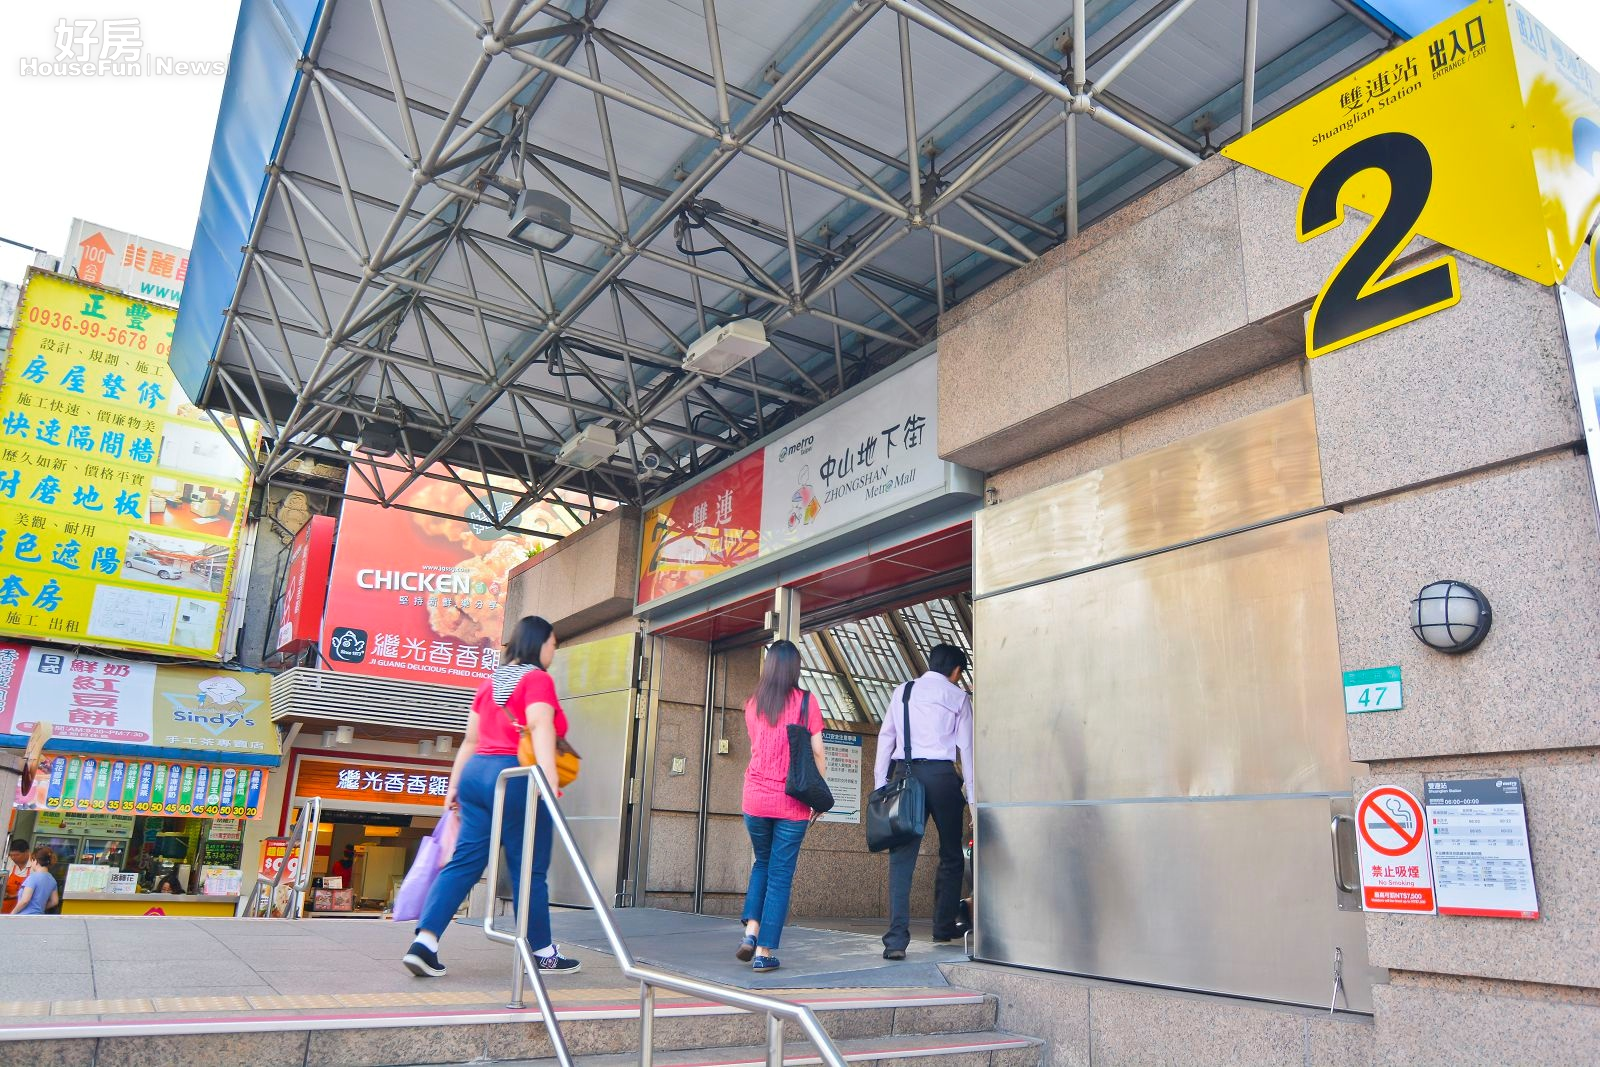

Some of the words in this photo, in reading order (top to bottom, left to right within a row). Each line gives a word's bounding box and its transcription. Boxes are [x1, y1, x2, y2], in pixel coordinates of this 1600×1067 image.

[1428, 15, 1486, 72] 出入口
[1432, 57, 1466, 80] ENTRANCE
[1472, 46, 1487, 58] EXIT
[1340, 57, 1417, 117] 雙連站
[1312, 107, 1375, 146] Shuanglian
[1379, 81, 1422, 109] Station
[85, 244, 106, 263] 100
[1301, 132, 1454, 352] 2
[29, 306, 148, 351] 0936-99-5678
[80, 293, 178, 339] 正豐
[21, 355, 166, 410] 房屋整修
[788, 435, 814, 456] metro
[820, 413, 926, 487] 中山地下街
[824, 465, 889, 504] ZHONGSHAN
[894, 468, 917, 489] Mall
[0, 528, 121, 575] 色遮陽
[356, 568, 471, 594] CHICKEN
[6, 611, 39, 628] 施工
[49, 617, 79, 633] 出租
[41, 655, 60, 674] 日式
[378, 660, 406, 668] GUANG
[407, 663, 447, 673] DELICIOUS
[448, 668, 471, 677] FRIED
[1358, 687, 1388, 707] 47
[173, 711, 255, 728] Sindy's
[336, 769, 449, 796] 繼光香香雞
[48, 797, 60, 807] 25
[63, 799, 74, 807] 25
[79, 800, 90, 808] 25
[92, 800, 105, 809] 30
[108, 801, 119, 809] 35
[122, 801, 133, 810] 35
[136, 802, 149, 811] 40
[151, 803, 162, 811] 50
[165, 804, 177, 812] 45
[178, 805, 191, 813] 40
[193, 805, 205, 814] 45
[206, 806, 218, 814] 40
[220, 806, 231, 815] 50
[233, 807, 244, 815] 30
[246, 807, 257, 816] 20
[1371, 864, 1420, 878] 禁止吸煙
